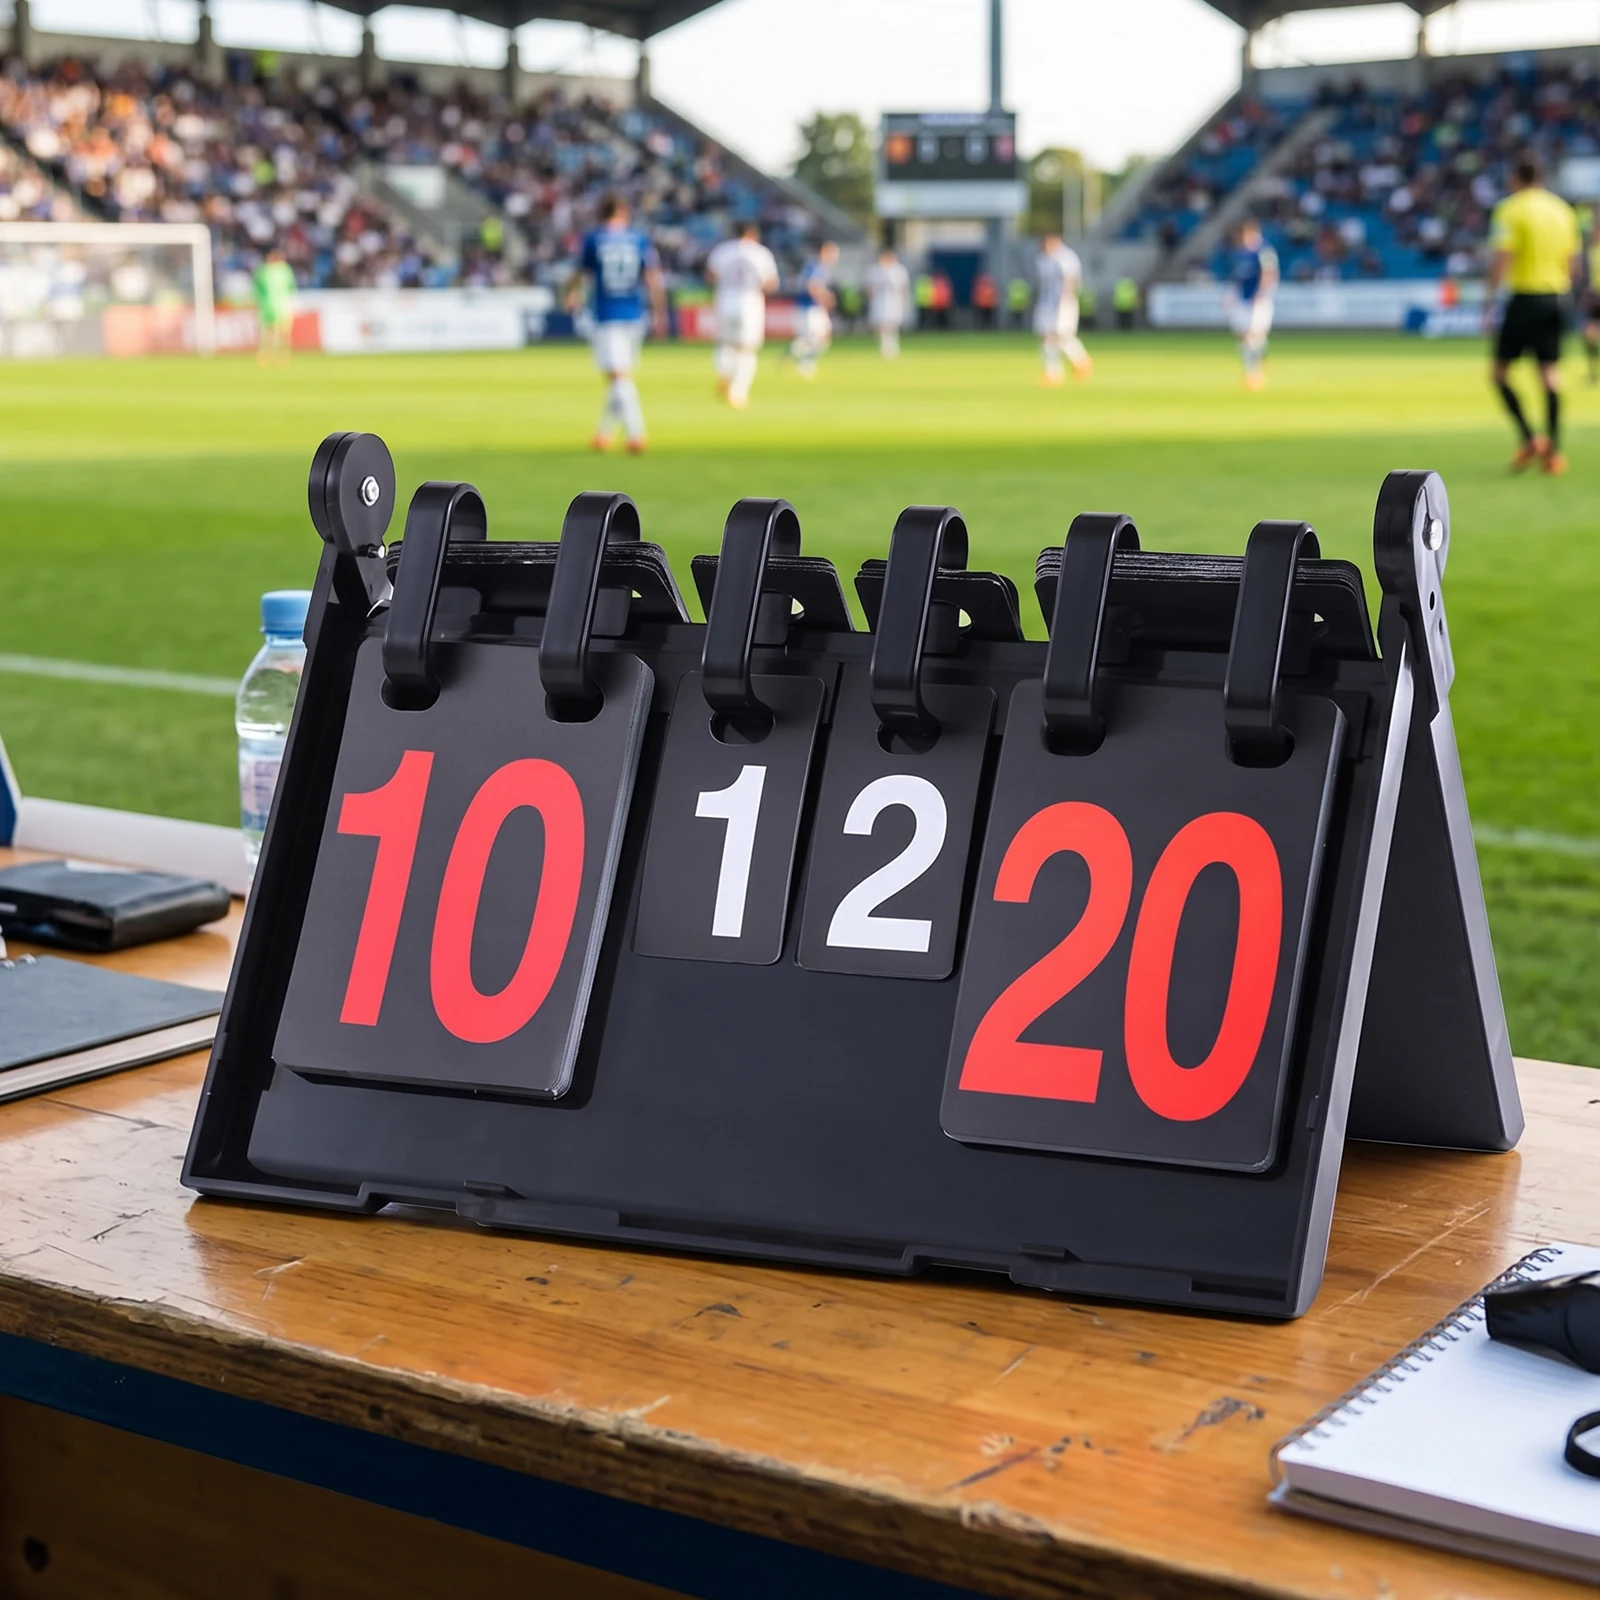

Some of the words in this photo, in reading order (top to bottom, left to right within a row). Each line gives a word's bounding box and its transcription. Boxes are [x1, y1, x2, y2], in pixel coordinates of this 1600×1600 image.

[338, 750, 585, 1044] 10
[695, 765, 767, 938] 1
[826, 774, 948, 953] 2
[959, 801, 1283, 1122] 20
